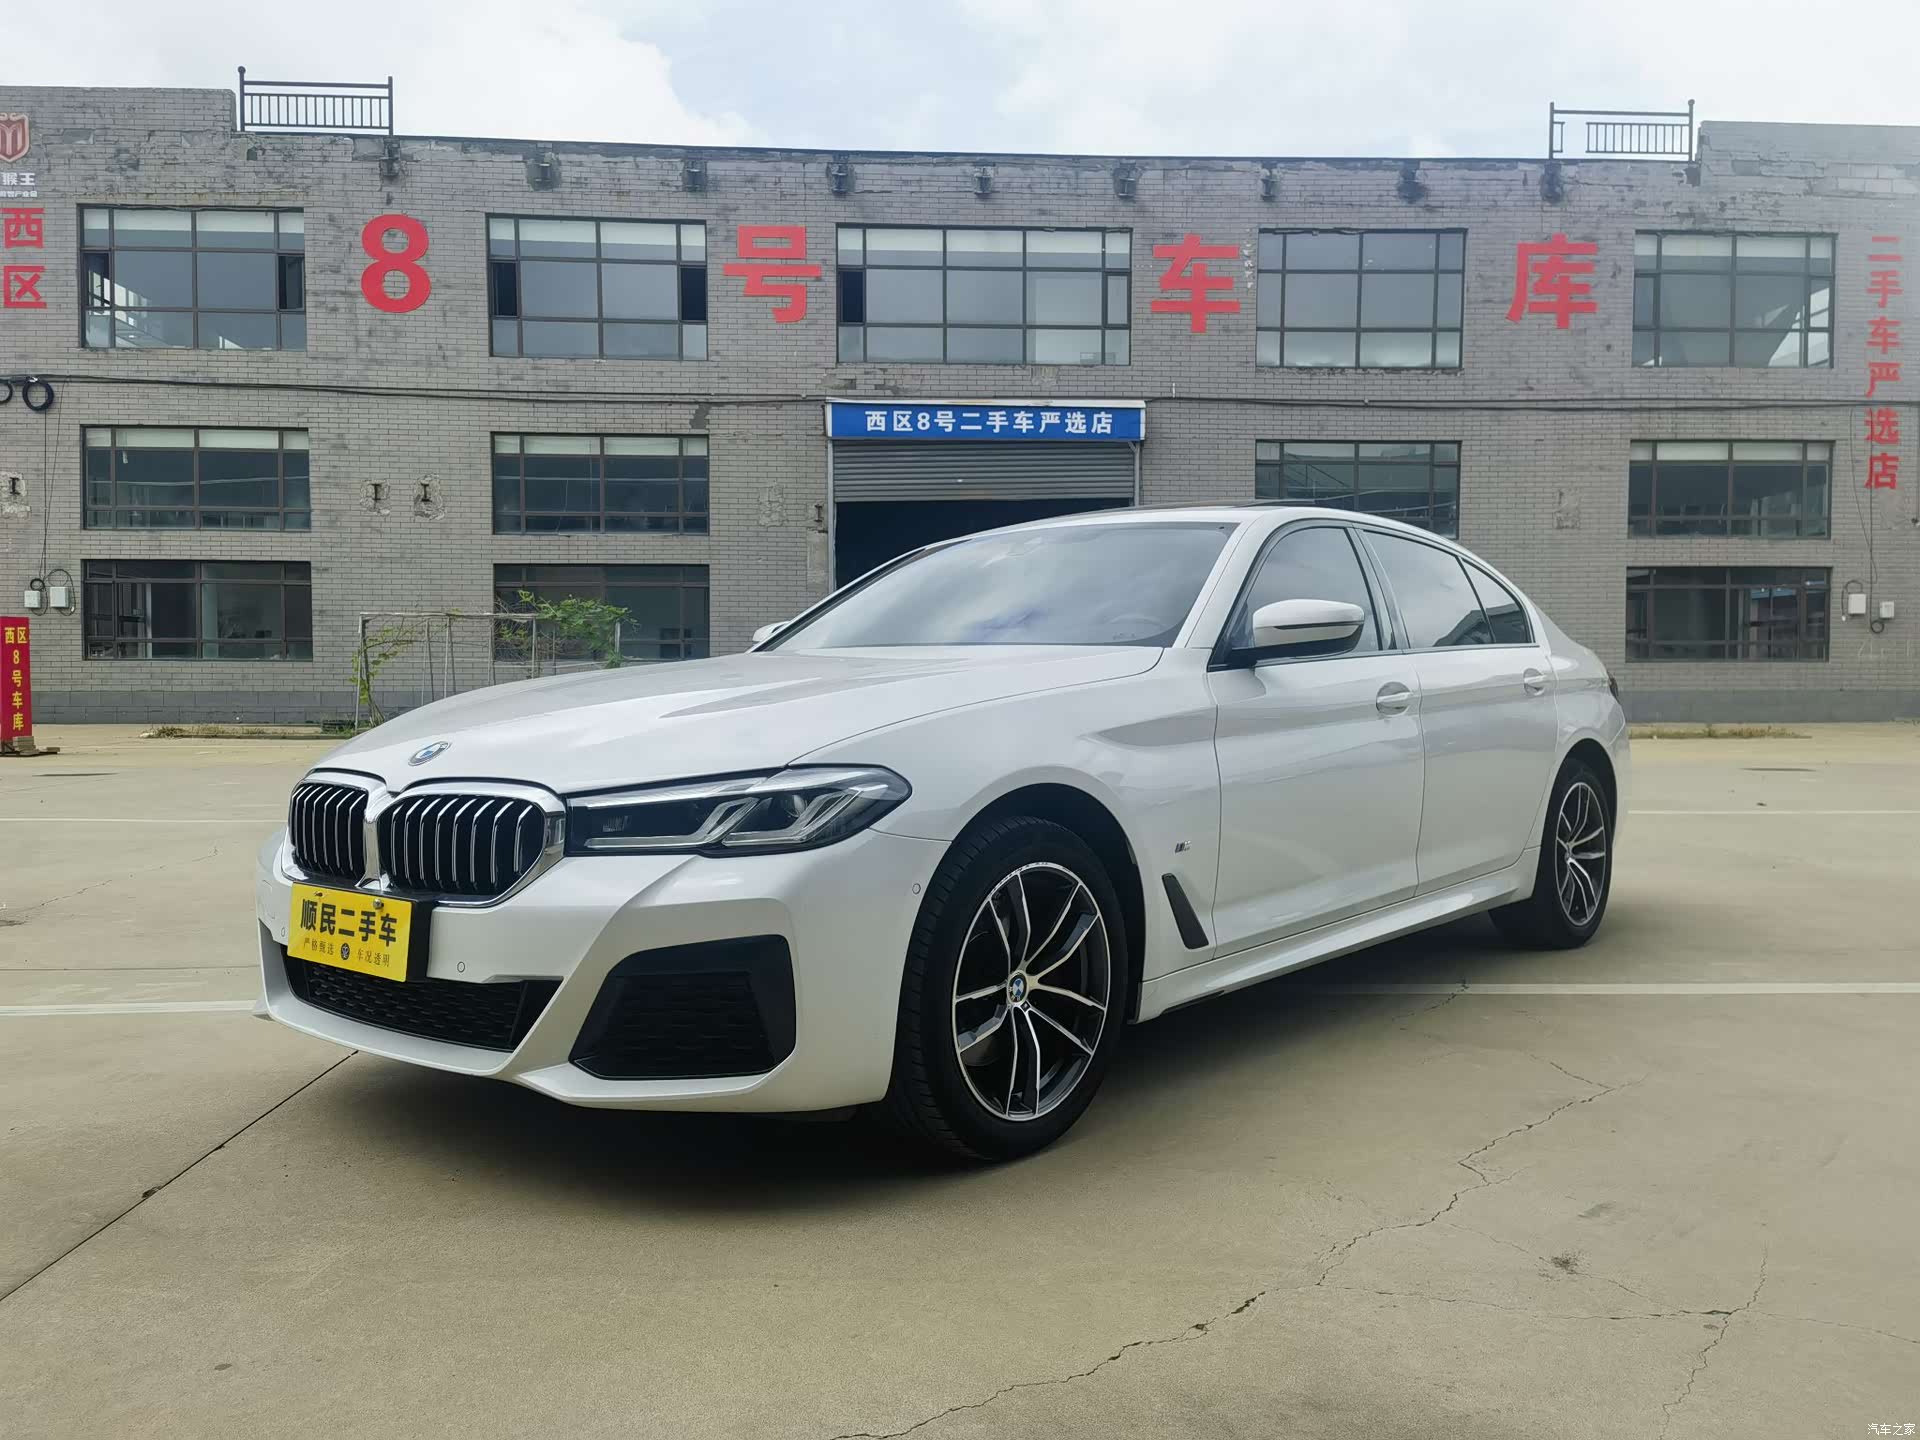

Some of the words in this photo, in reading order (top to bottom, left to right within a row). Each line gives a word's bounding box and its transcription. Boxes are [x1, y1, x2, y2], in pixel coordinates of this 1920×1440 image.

[0, 207, 47, 309] 西区
[1863, 235, 1904, 490] 二手车严选店
[864, 410, 1113, 435] 西区8号二手车严选店
[4, 626, 28, 644] 西区
[300, 898, 398, 948] 顺民二手车
